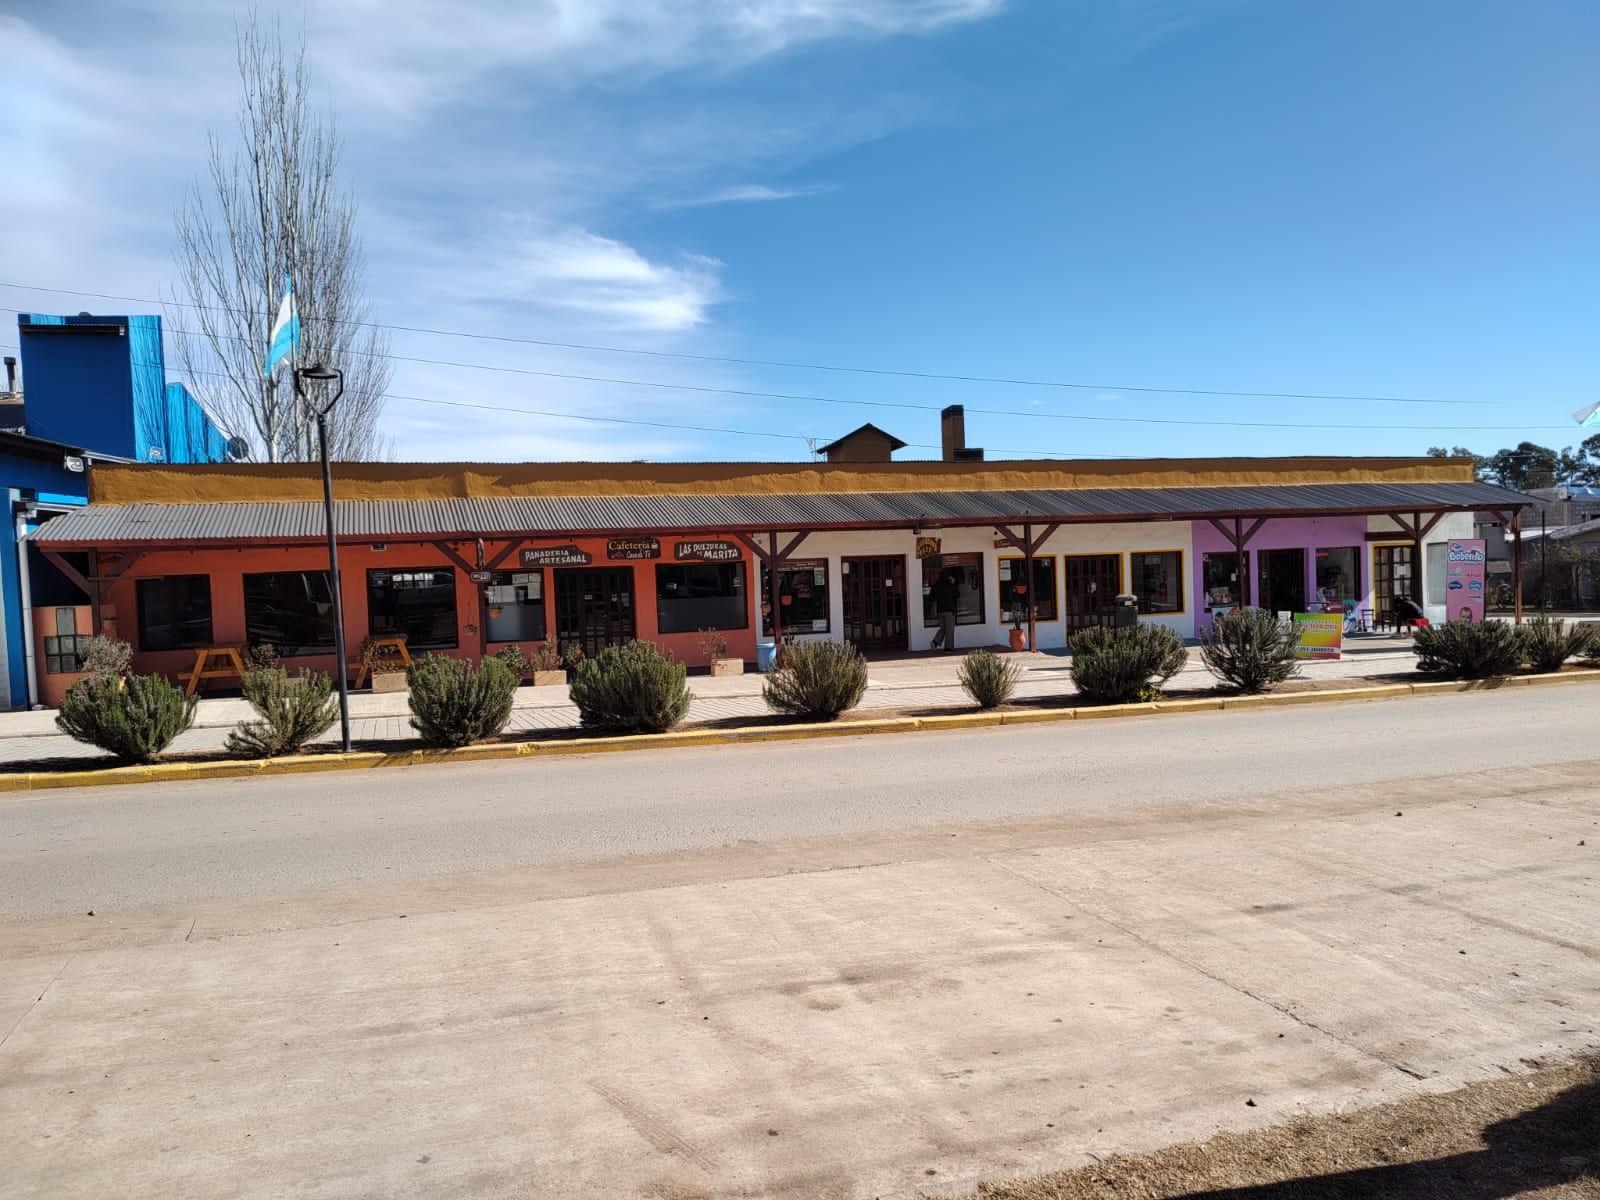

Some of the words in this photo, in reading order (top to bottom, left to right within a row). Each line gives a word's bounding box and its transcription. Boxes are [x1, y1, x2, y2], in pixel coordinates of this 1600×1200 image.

[679, 543, 692, 558] LAS
[703, 548, 738, 560] MARITA
[539, 554, 587, 565] ARTESANAL
